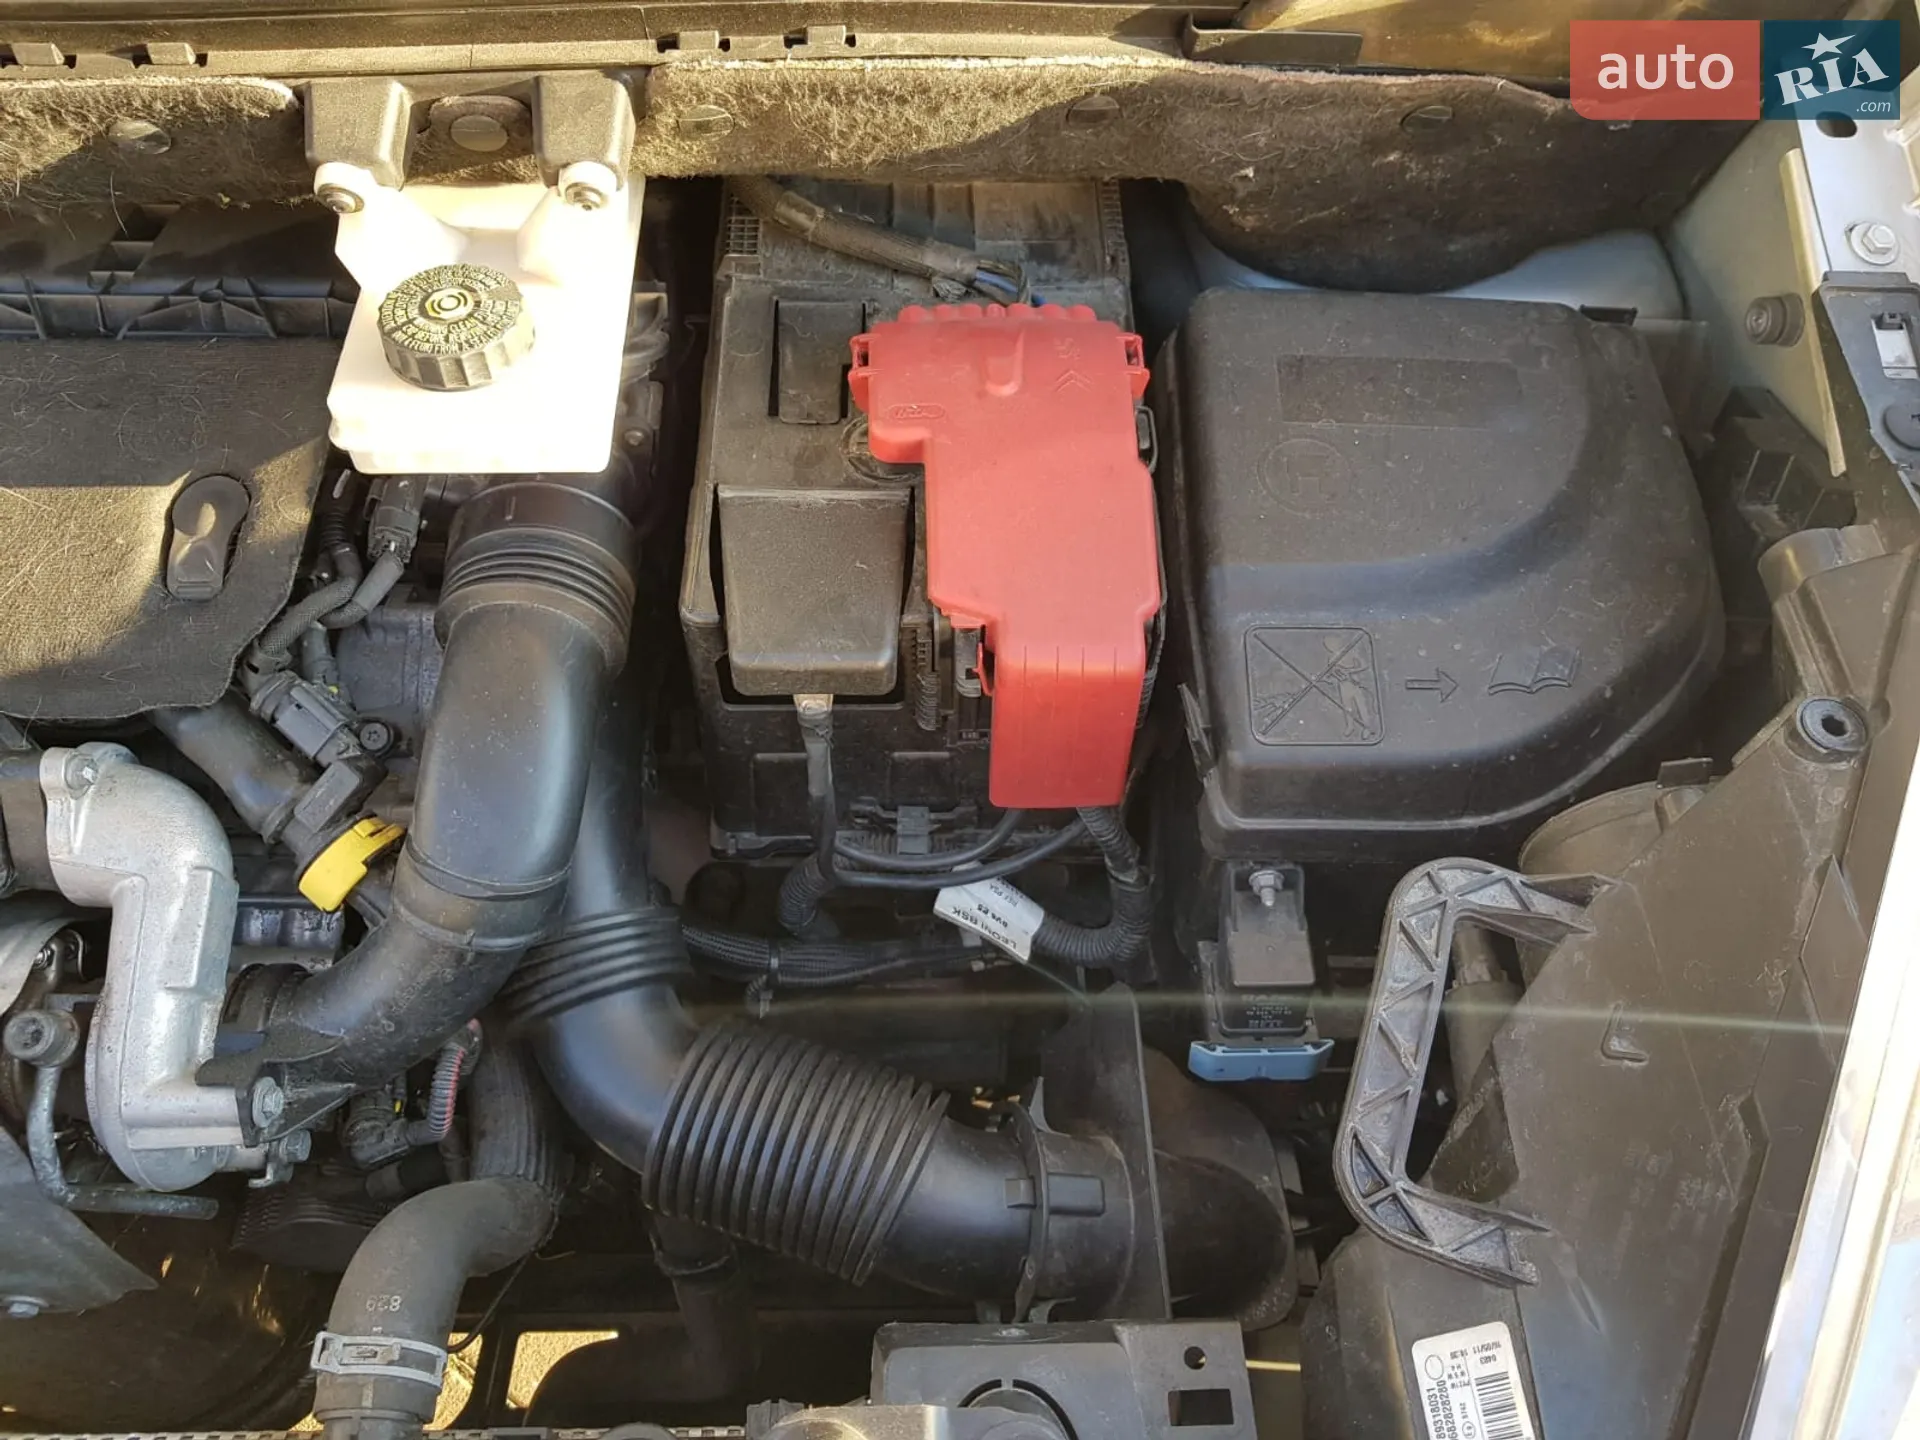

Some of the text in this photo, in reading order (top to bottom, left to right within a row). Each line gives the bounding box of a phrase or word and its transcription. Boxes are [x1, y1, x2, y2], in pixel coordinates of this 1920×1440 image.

[449, 316, 479, 335] CLEAN
[434, 342, 460, 356] FROM
[981, 921, 1017, 949] LEONI
[1426, 1387, 1446, 1440] 89318031
[1436, 1380, 1458, 1440] 682828280
